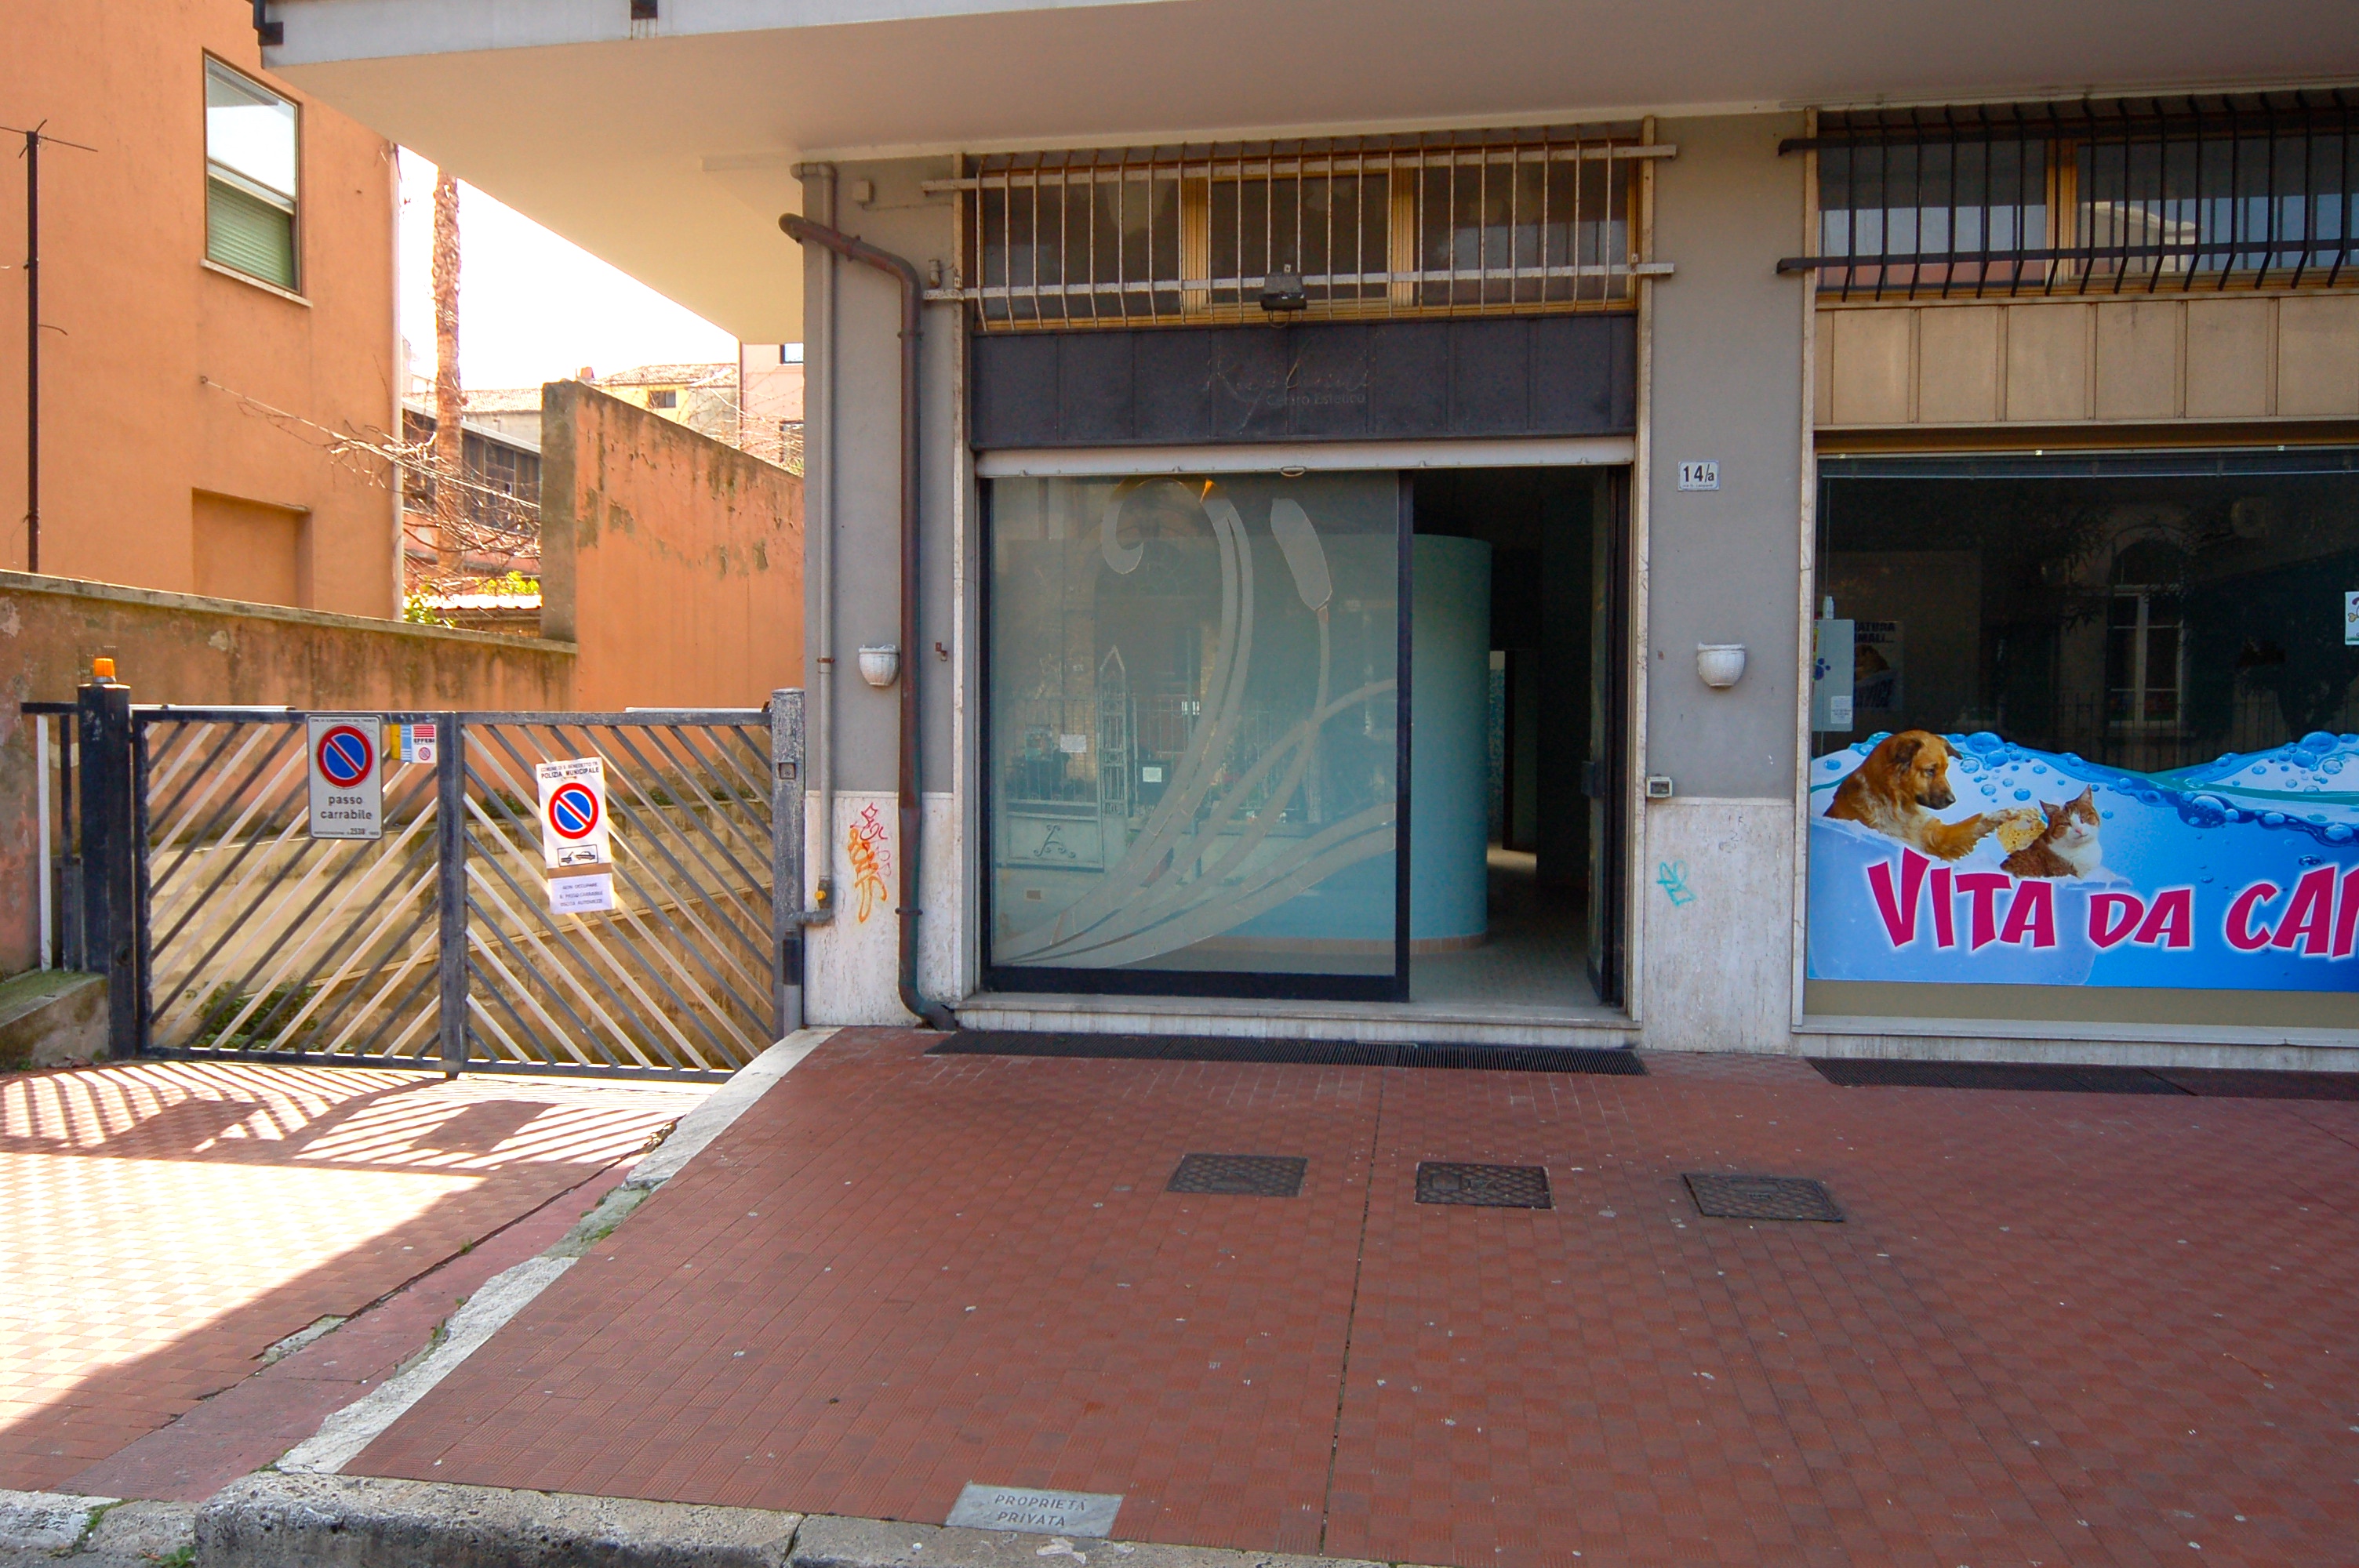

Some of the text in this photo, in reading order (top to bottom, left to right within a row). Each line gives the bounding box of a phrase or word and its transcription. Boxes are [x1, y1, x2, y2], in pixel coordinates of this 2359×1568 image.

[1683, 464, 1714, 482] 14/a
[565, 767, 600, 776] MUNICIPALE
[328, 796, 363, 807] passo
[320, 809, 373, 820] carrabile
[1866, 847, 2056, 952] VITA
[2088, 888, 2191, 949] DA
[996, 1511, 1065, 1526] PRIVATA
